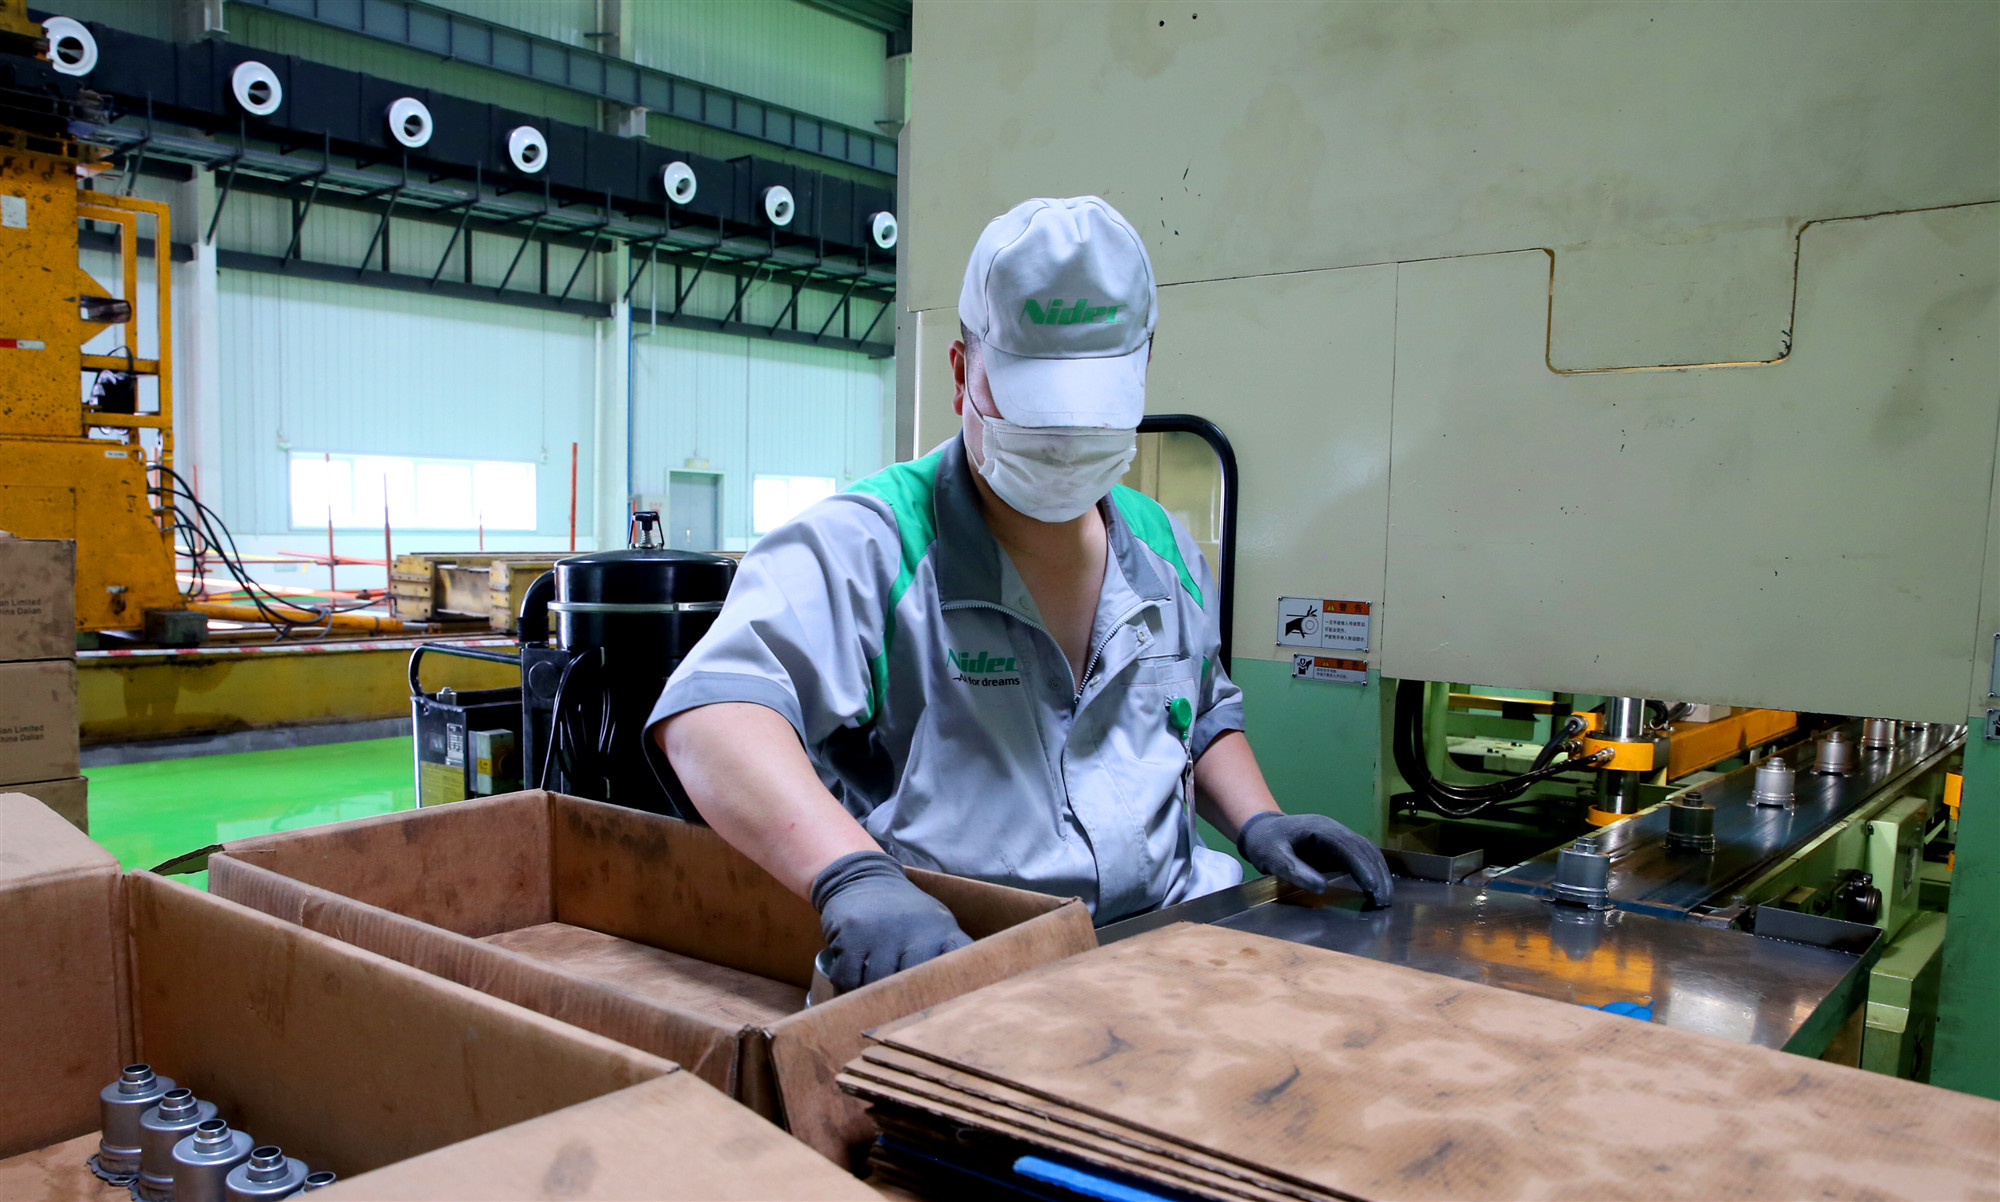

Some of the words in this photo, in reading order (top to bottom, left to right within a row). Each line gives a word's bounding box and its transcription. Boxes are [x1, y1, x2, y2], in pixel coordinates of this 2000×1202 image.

[1019, 299, 1127, 325] Nidec
[11, 598, 41, 606] Limited
[17, 607, 42, 615] Dalian
[946, 648, 1019, 673] Nidec
[968, 676, 980, 686] for
[981, 677, 1020, 686] dreams
[14, 724, 44, 733] Limited
[20, 734, 44, 742] Dalian
